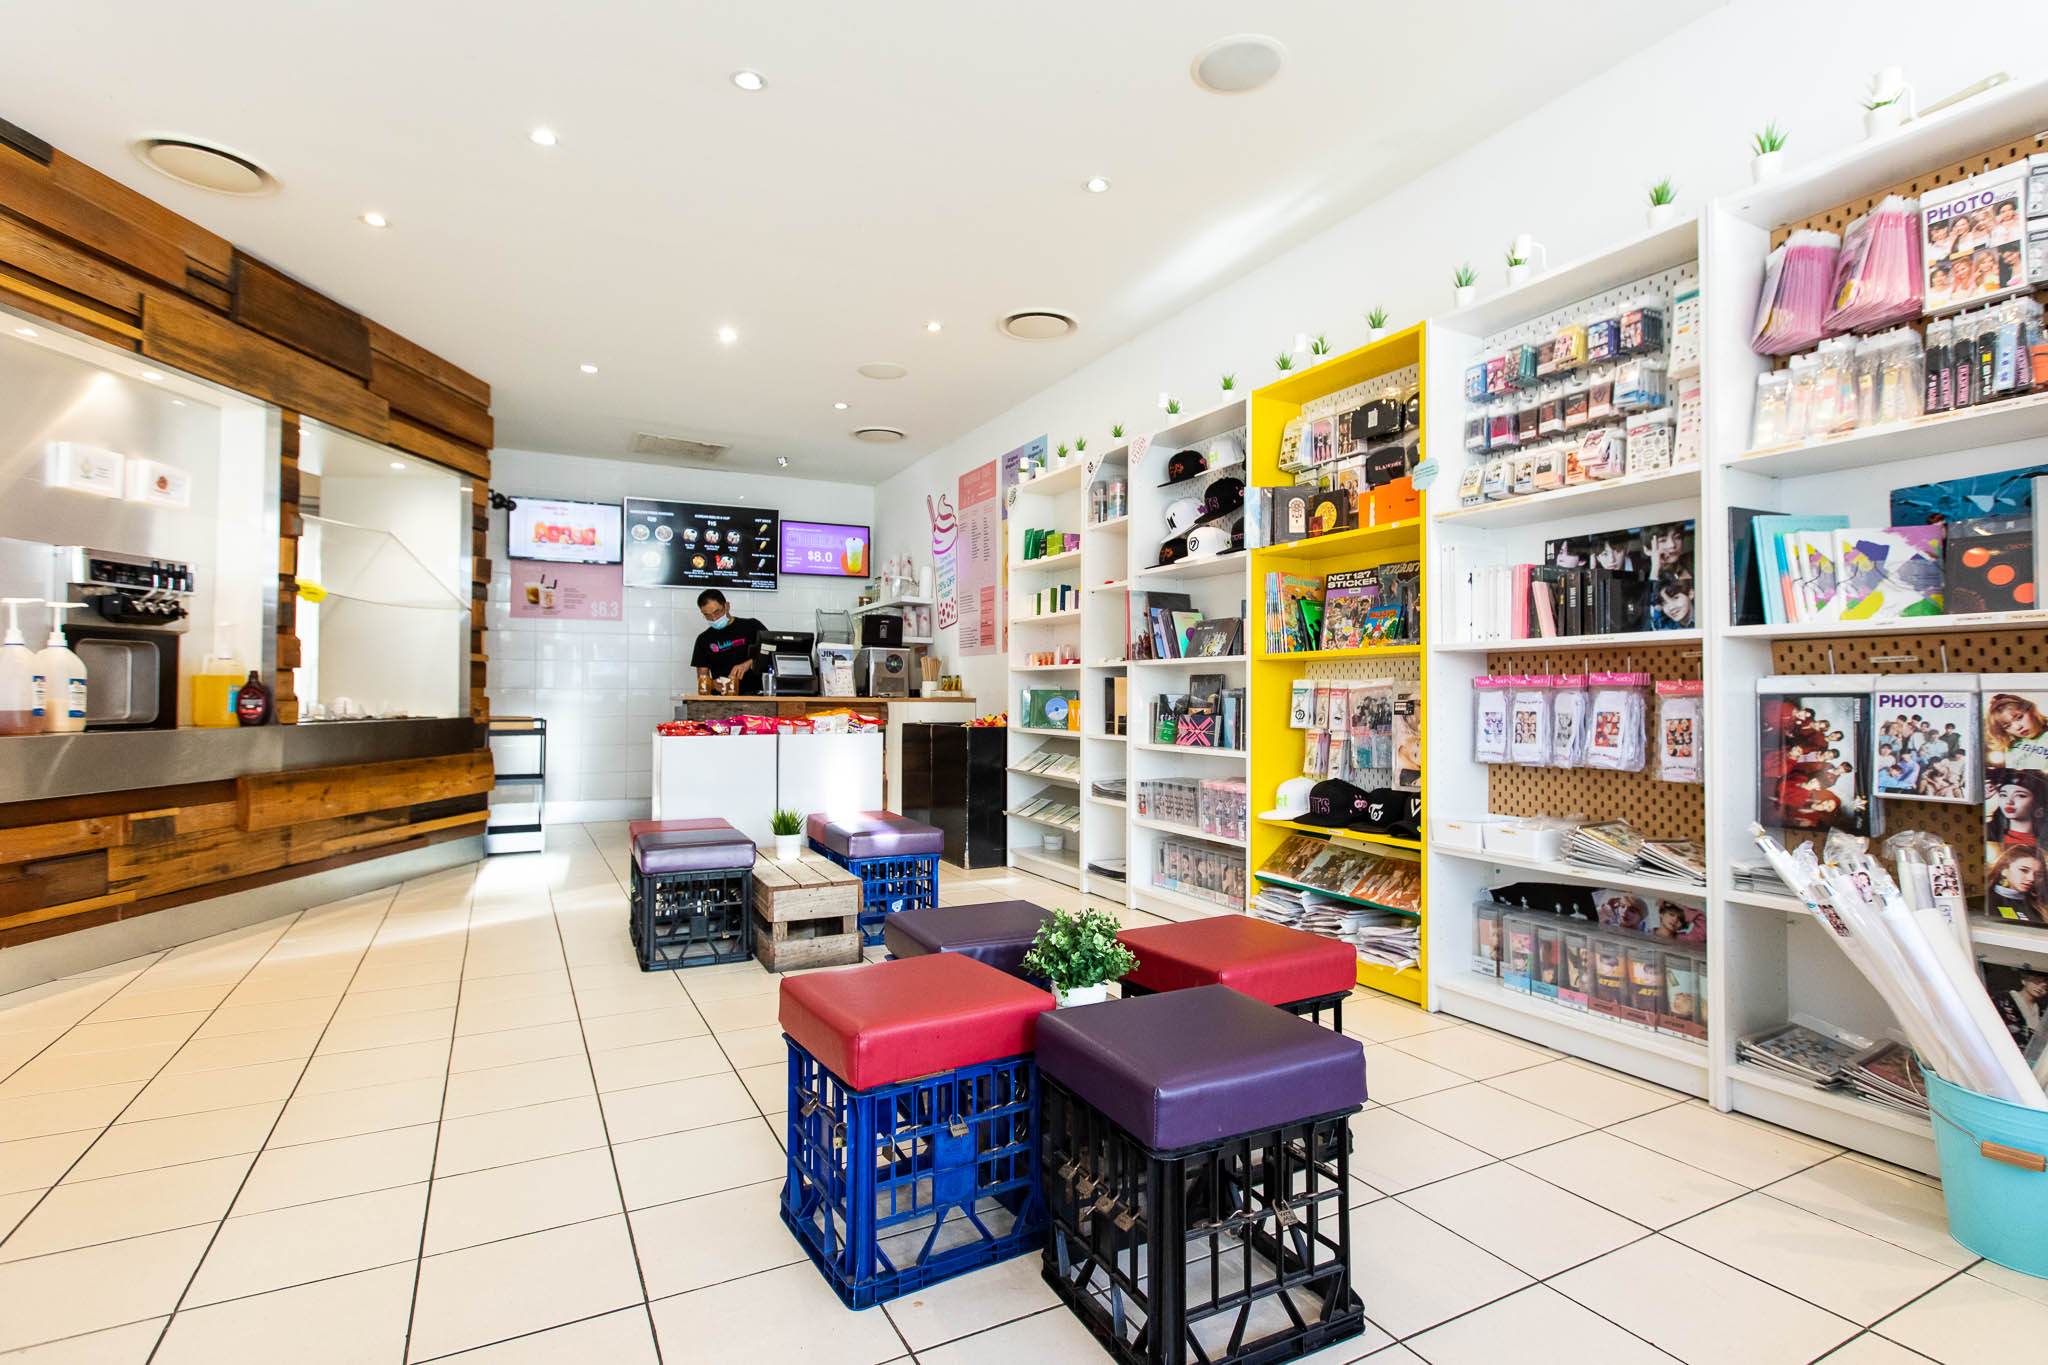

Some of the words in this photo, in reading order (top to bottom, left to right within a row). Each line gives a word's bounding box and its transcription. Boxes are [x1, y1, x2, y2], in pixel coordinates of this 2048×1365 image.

[1926, 191, 1995, 223] PHOTO
[807, 550, 833, 563] $8.0
[1327, 574, 1353, 582] NCT
[1353, 570, 1372, 580] 127
[1327, 577, 1378, 589] STICKER
[590, 600, 619, 617] $6.3
[821, 650, 835, 658] JIN
[1879, 694, 1943, 708] PHOTO
